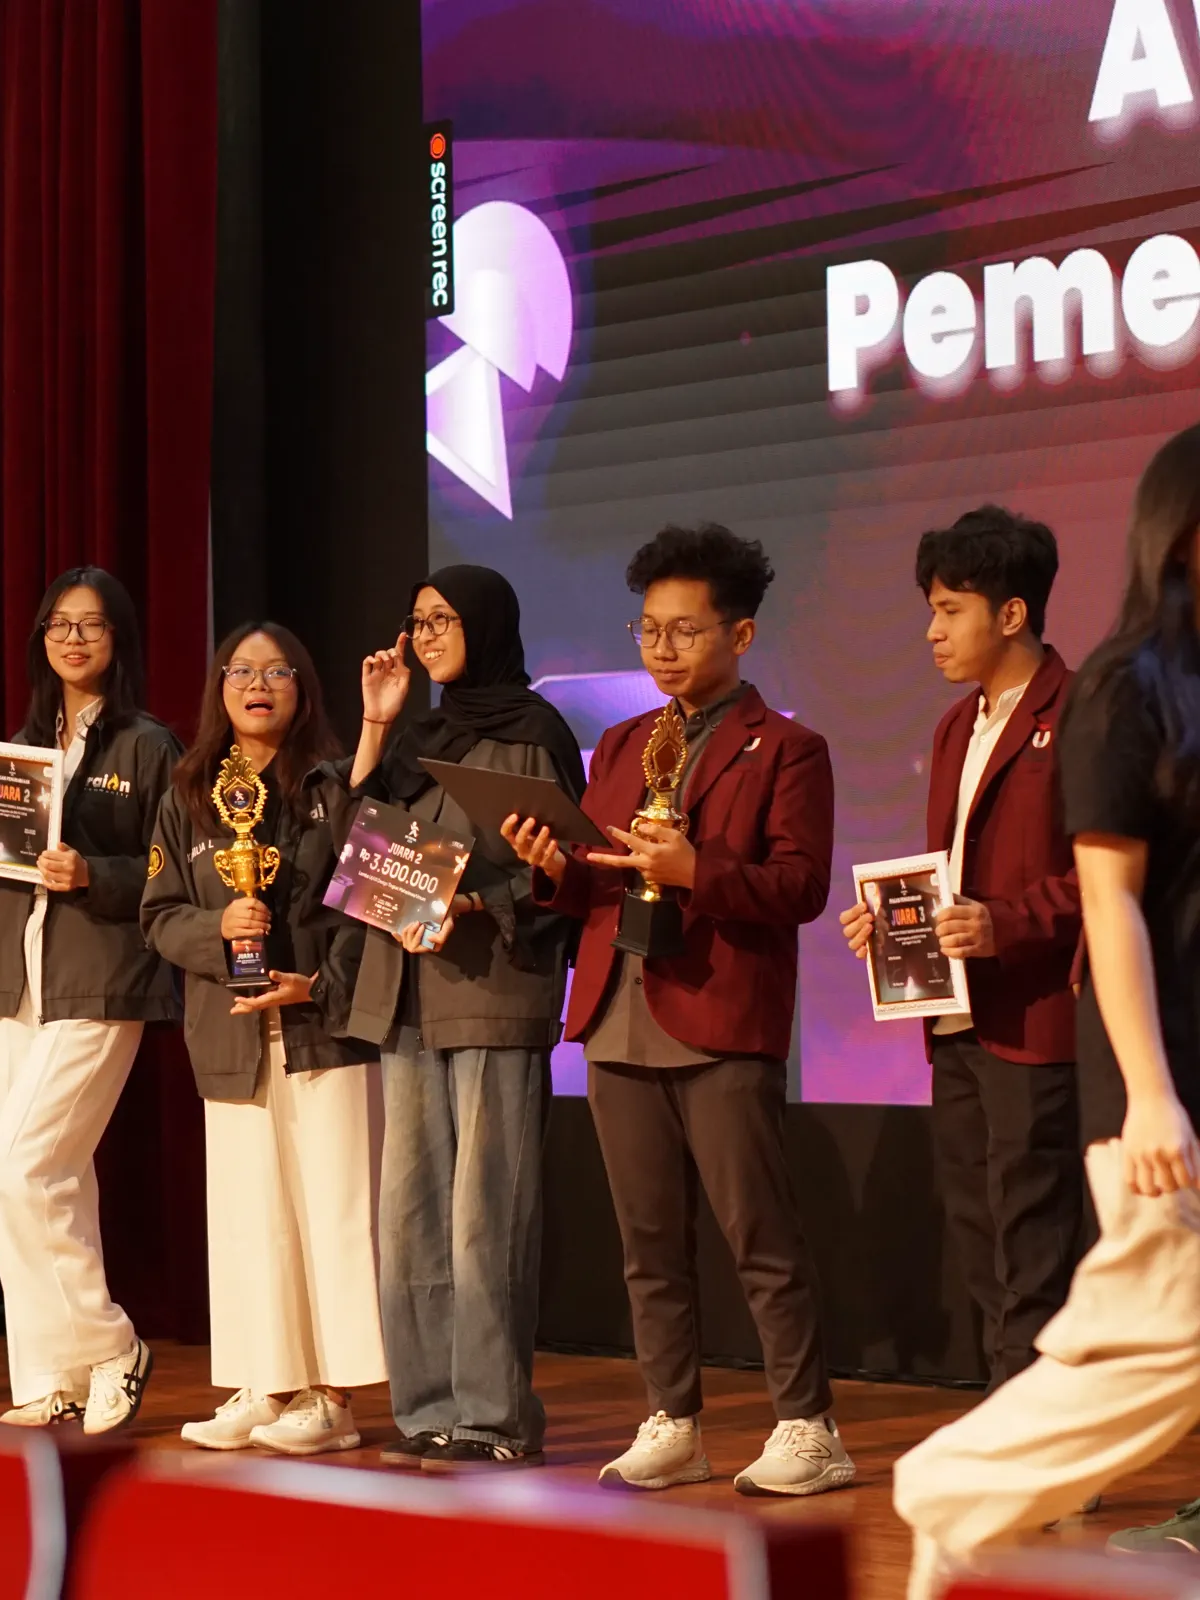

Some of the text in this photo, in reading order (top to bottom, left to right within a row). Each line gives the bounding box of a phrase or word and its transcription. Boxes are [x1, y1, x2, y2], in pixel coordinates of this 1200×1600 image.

[1088, 0, 1200, 122] A
[430, 161, 448, 306] screenrec
[826, 234, 1200, 392] Peme
[23, 788, 31, 803] 2
[359, 847, 439, 894] Rp 3.500.000
[387, 842, 424, 865] JUARA 2
[891, 905, 926, 927] JUARA 3
